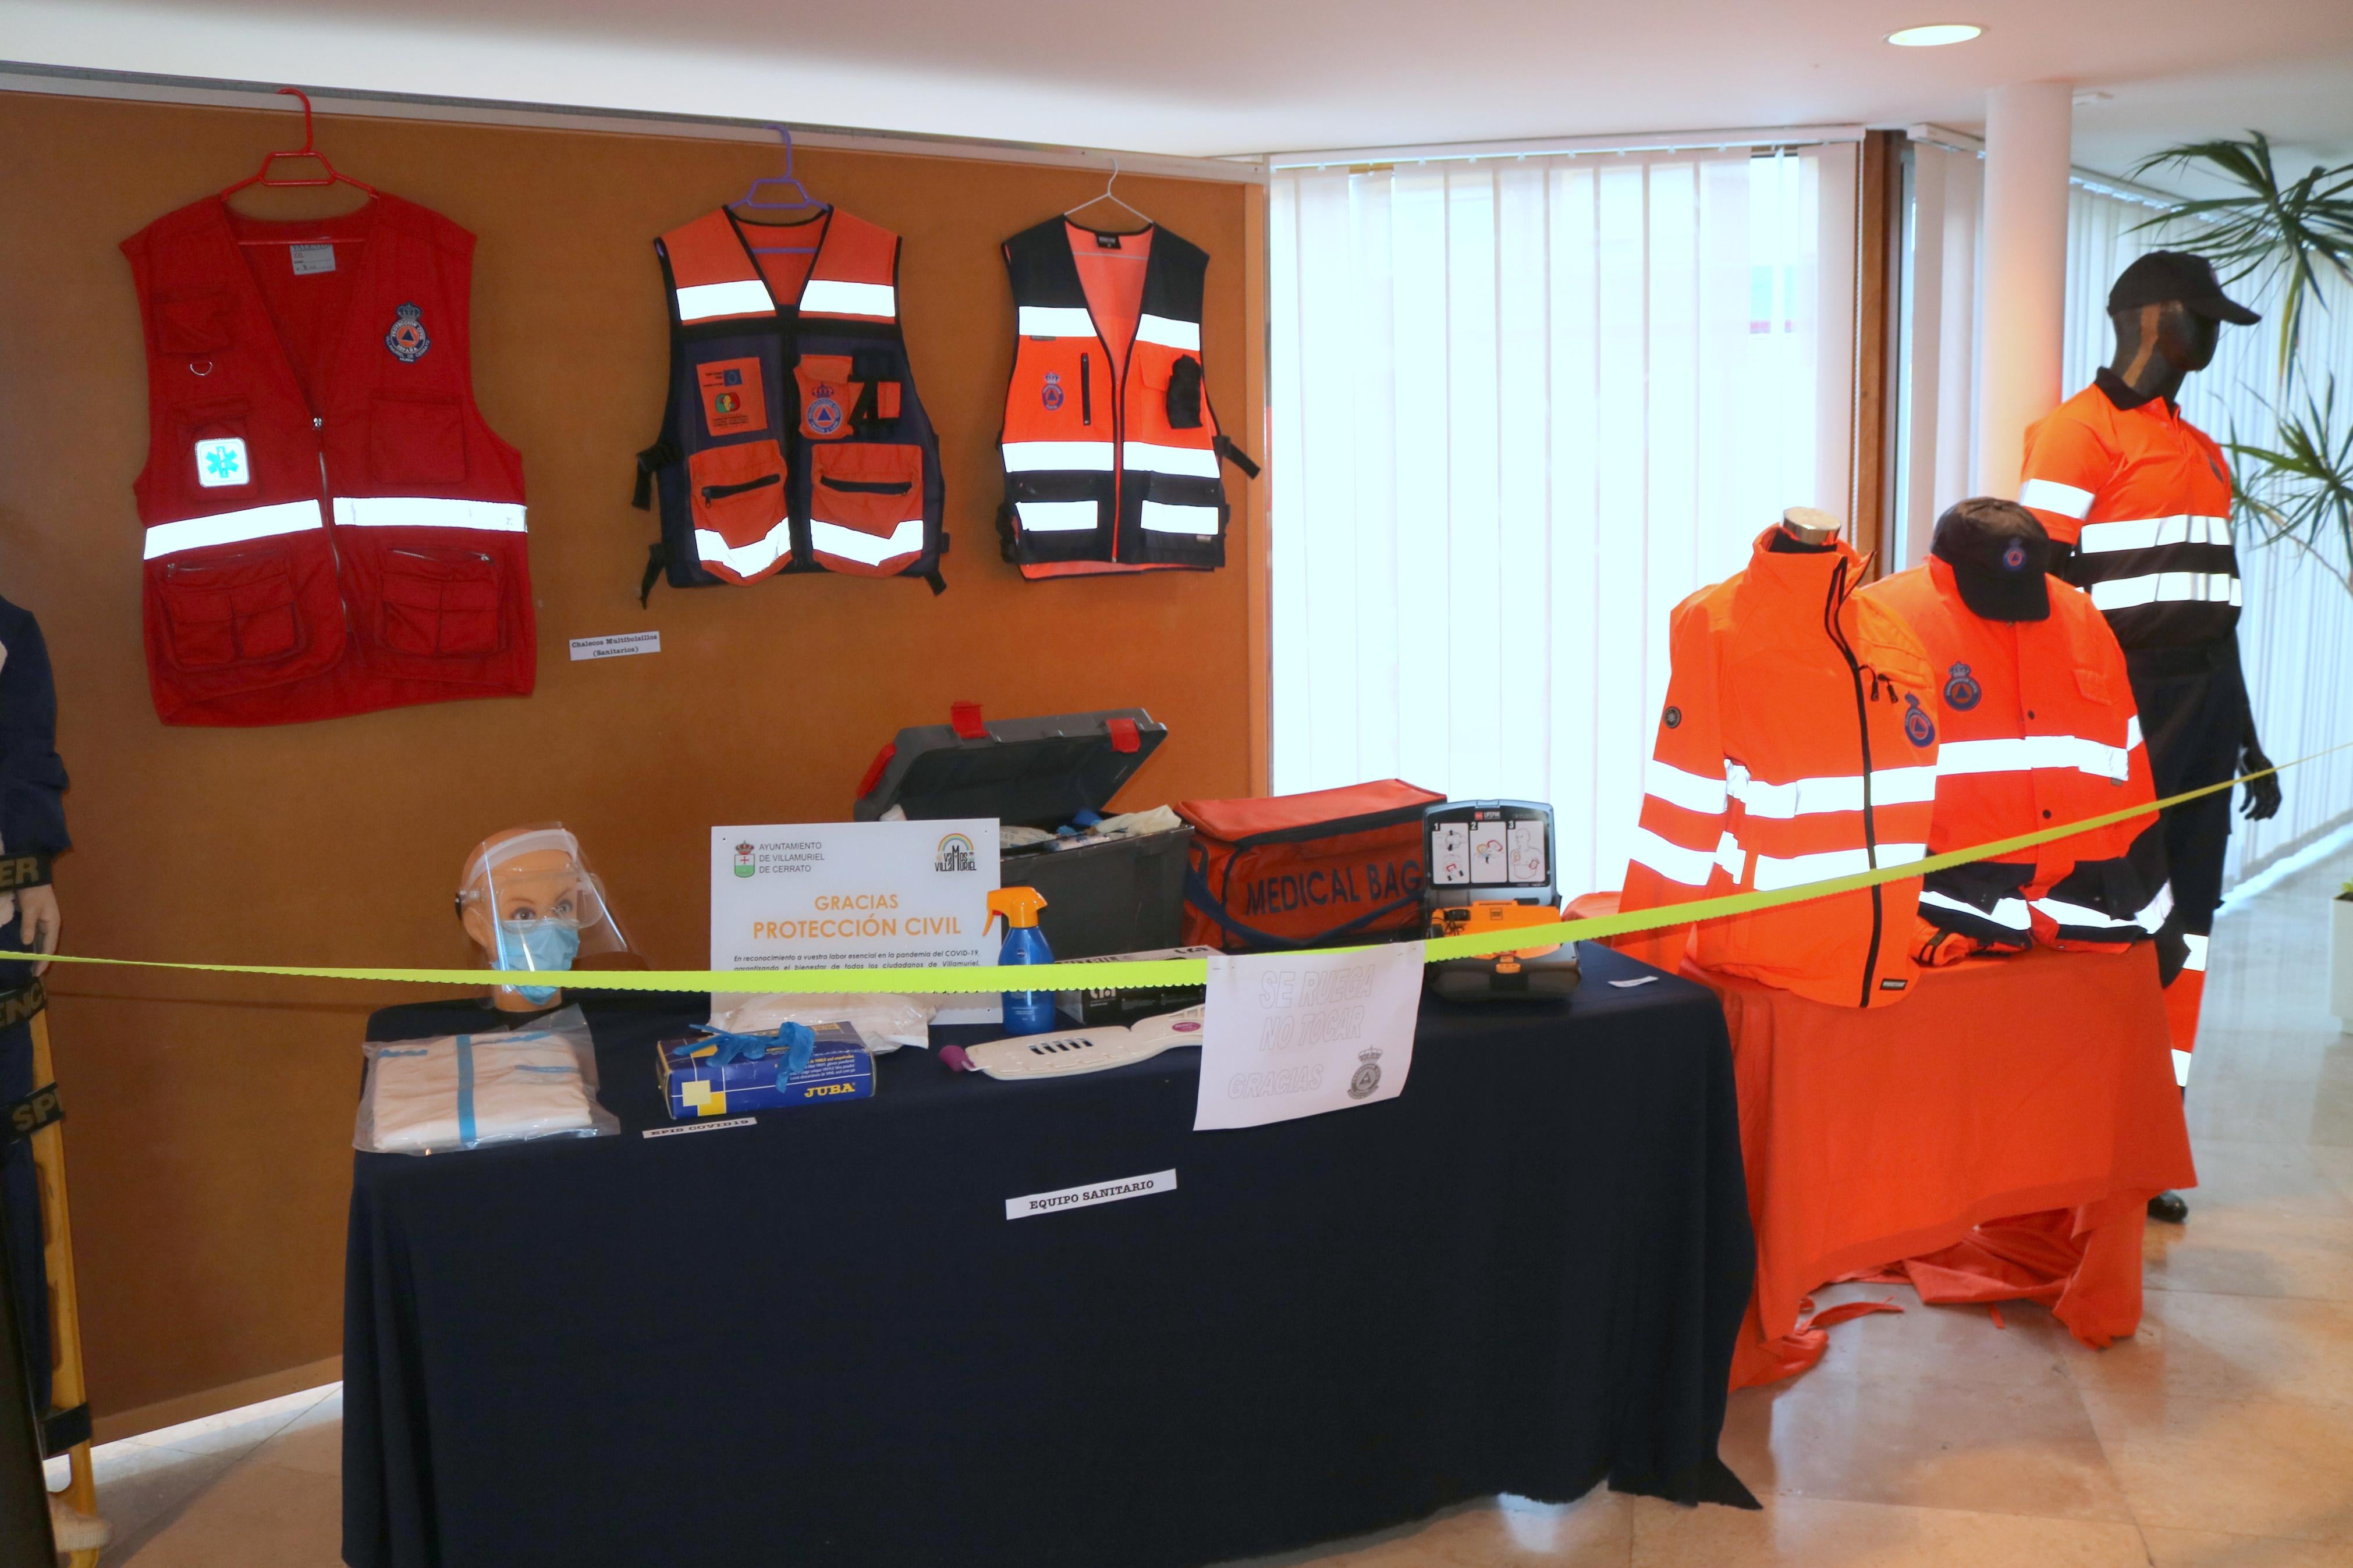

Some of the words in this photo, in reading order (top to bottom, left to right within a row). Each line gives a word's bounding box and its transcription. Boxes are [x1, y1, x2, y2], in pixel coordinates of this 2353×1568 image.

[606, 634, 657, 644] Multibolsillos
[593, 647, 638, 656] (Sanitarios)
[1471, 822, 1477, 830] 2
[1509, 820, 1514, 829] 3
[759, 842, 822, 851] AYUNTAMIENTO
[772, 854, 825, 862] VILLAMURIEL
[772, 865, 811, 873] CERRATO
[1245, 870, 1360, 917] MEDICAL
[1365, 859, 1421, 901] BAG
[814, 894, 898, 911] GRACIAS
[753, 913, 896, 940] PROTECCIÓN
[904, 917, 961, 936] CIVIL
[896, 951, 931, 959] pandemia
[1259, 970, 1296, 1009] SE
[1298, 963, 1375, 1007] RUEGA
[1259, 1015, 1294, 1051] NO
[1298, 1005, 1365, 1047] TOCAR
[1227, 1064, 1324, 1100] GRACIAS
[804, 1083, 856, 1098] JUBA
[688, 1120, 749, 1130] COVID19
[1029, 1194, 1079, 1210] EQUIPO
[1083, 1180, 1154, 1201] SANITARIO
